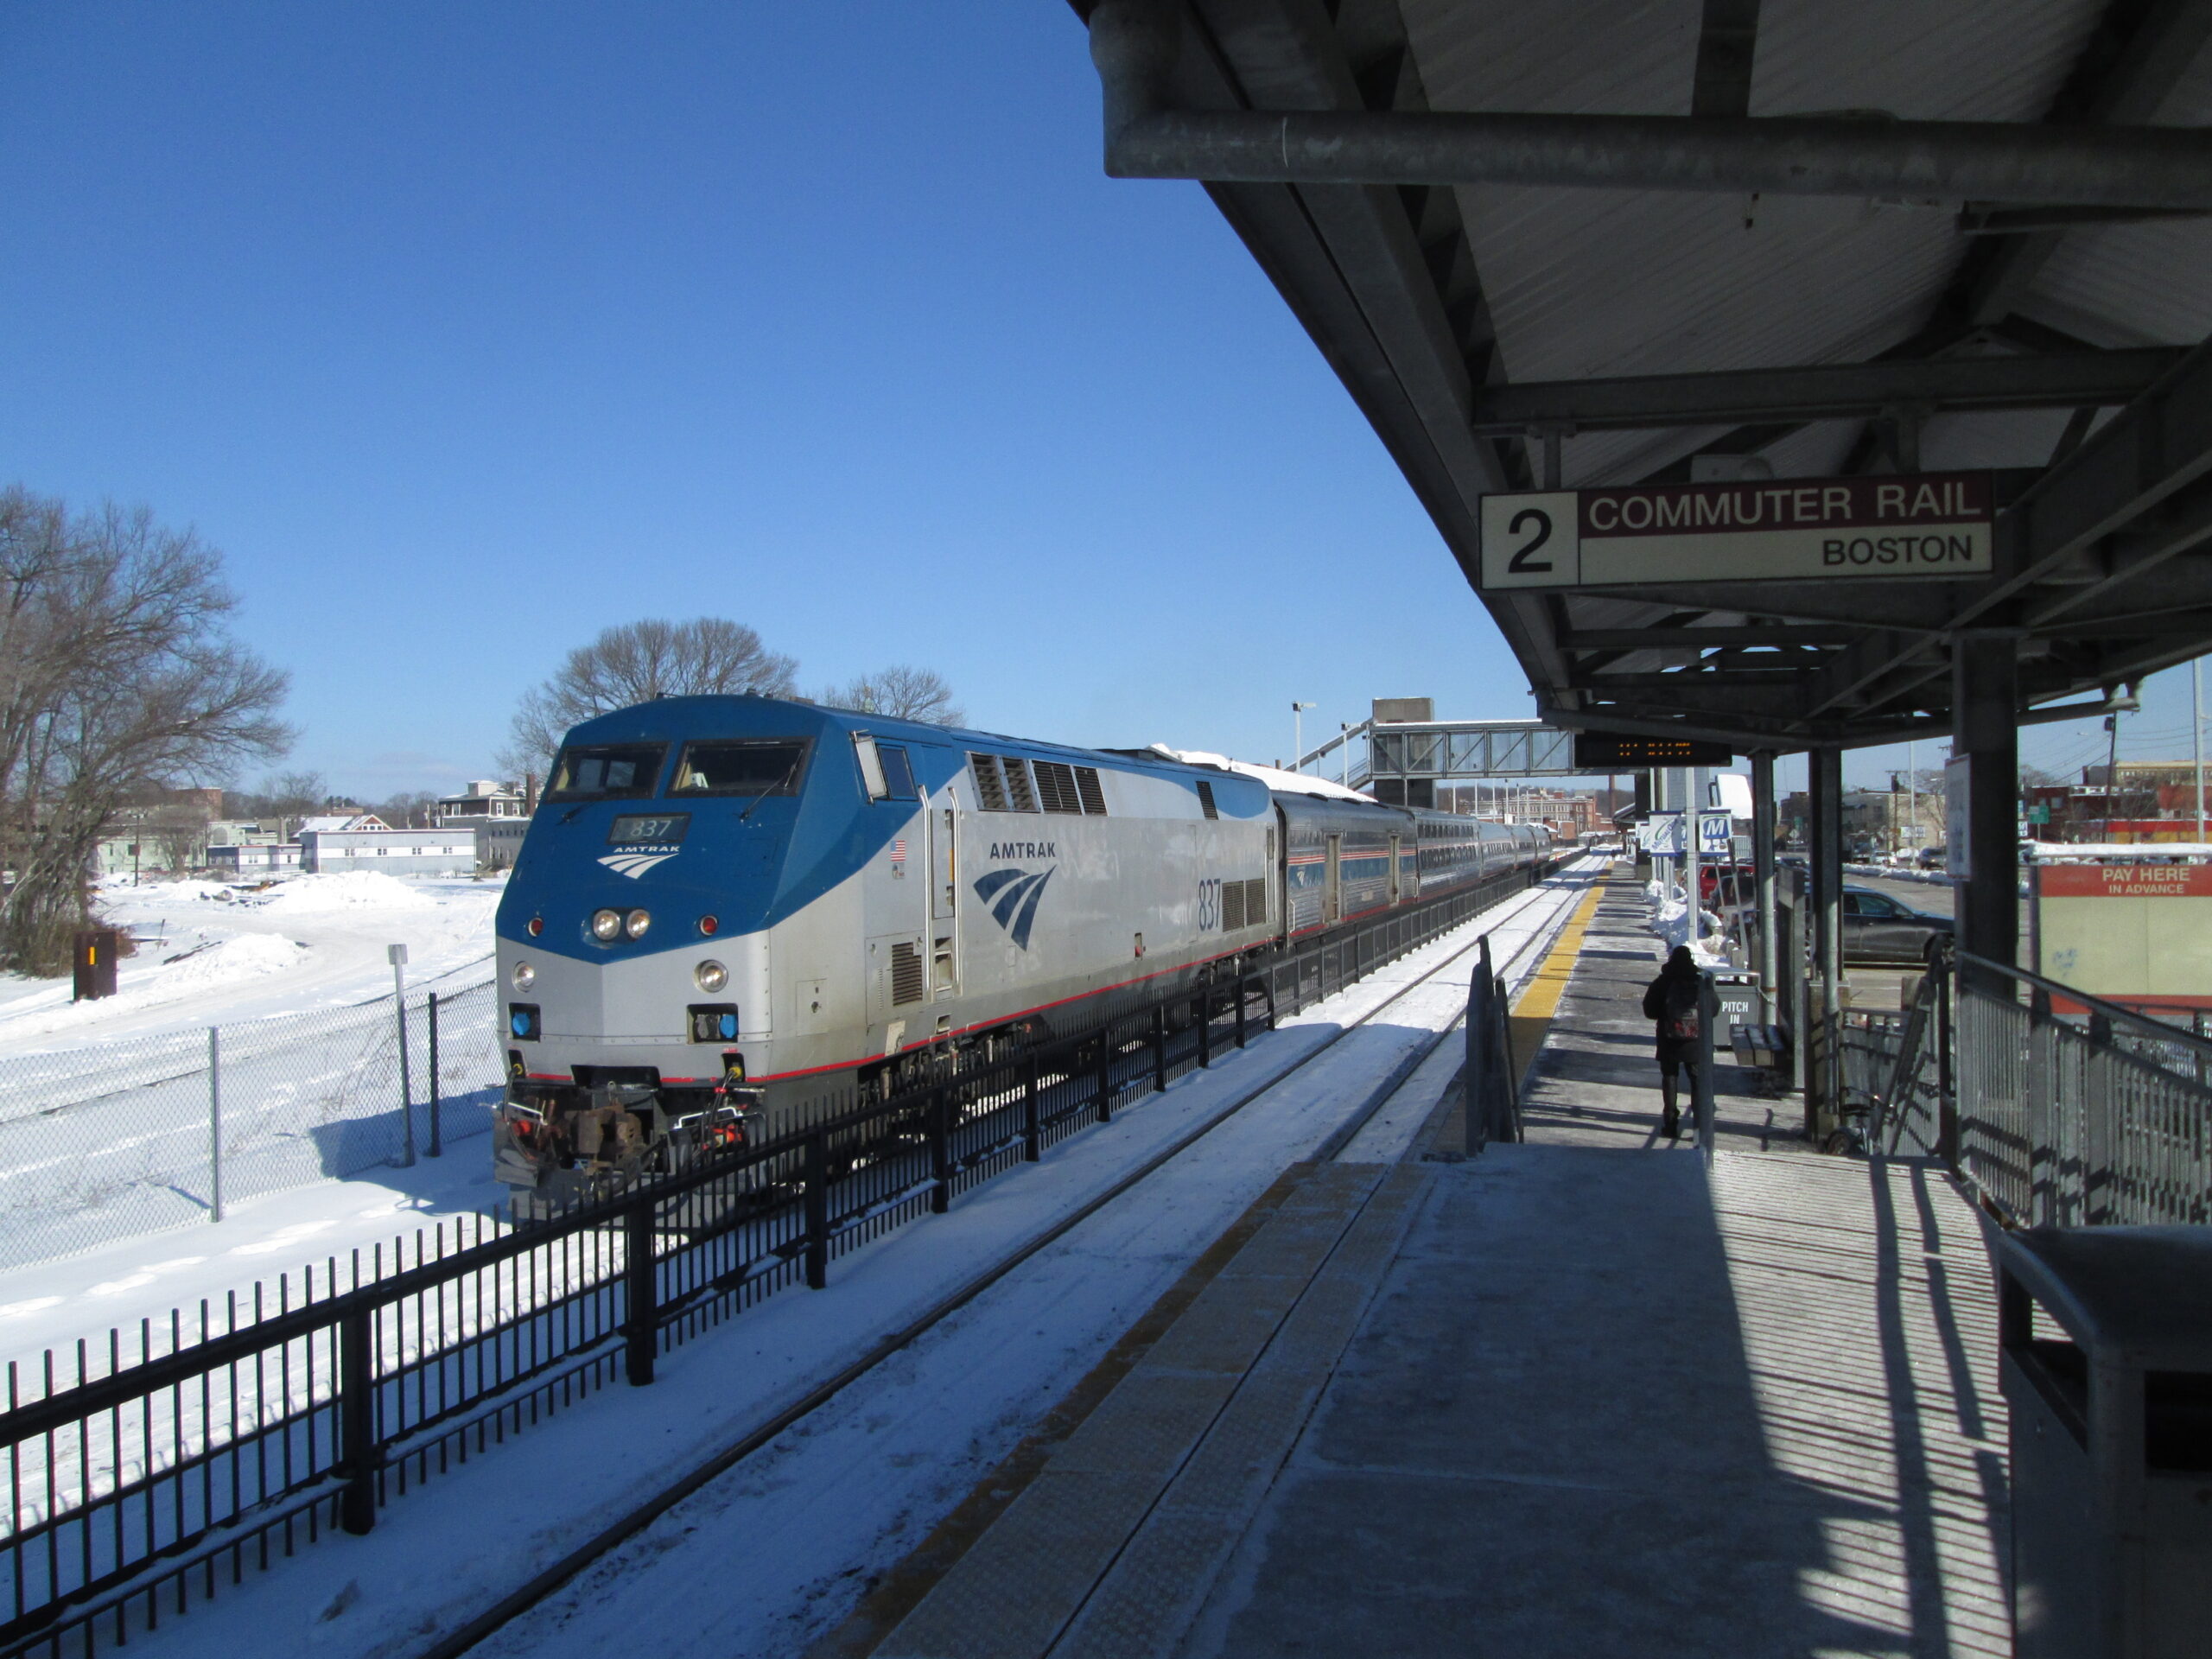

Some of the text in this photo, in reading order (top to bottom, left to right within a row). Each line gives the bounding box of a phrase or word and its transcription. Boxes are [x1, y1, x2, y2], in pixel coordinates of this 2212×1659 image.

[1588, 481, 1981, 531] COMMUTER RAIL
[1508, 508, 1553, 574] 2
[1823, 536, 1973, 566] BOSTON
[630, 820, 671, 837] 837
[1707, 819, 1725, 836] M
[990, 842, 1056, 859] AMTRAK
[2102, 867, 2190, 881] PAY HERE
[2108, 883, 2184, 894] IN ADVANCE
[1198, 878, 1222, 931] 837
[1722, 1001, 1749, 1013] PITCH
[1729, 1014, 1740, 1024] IN
